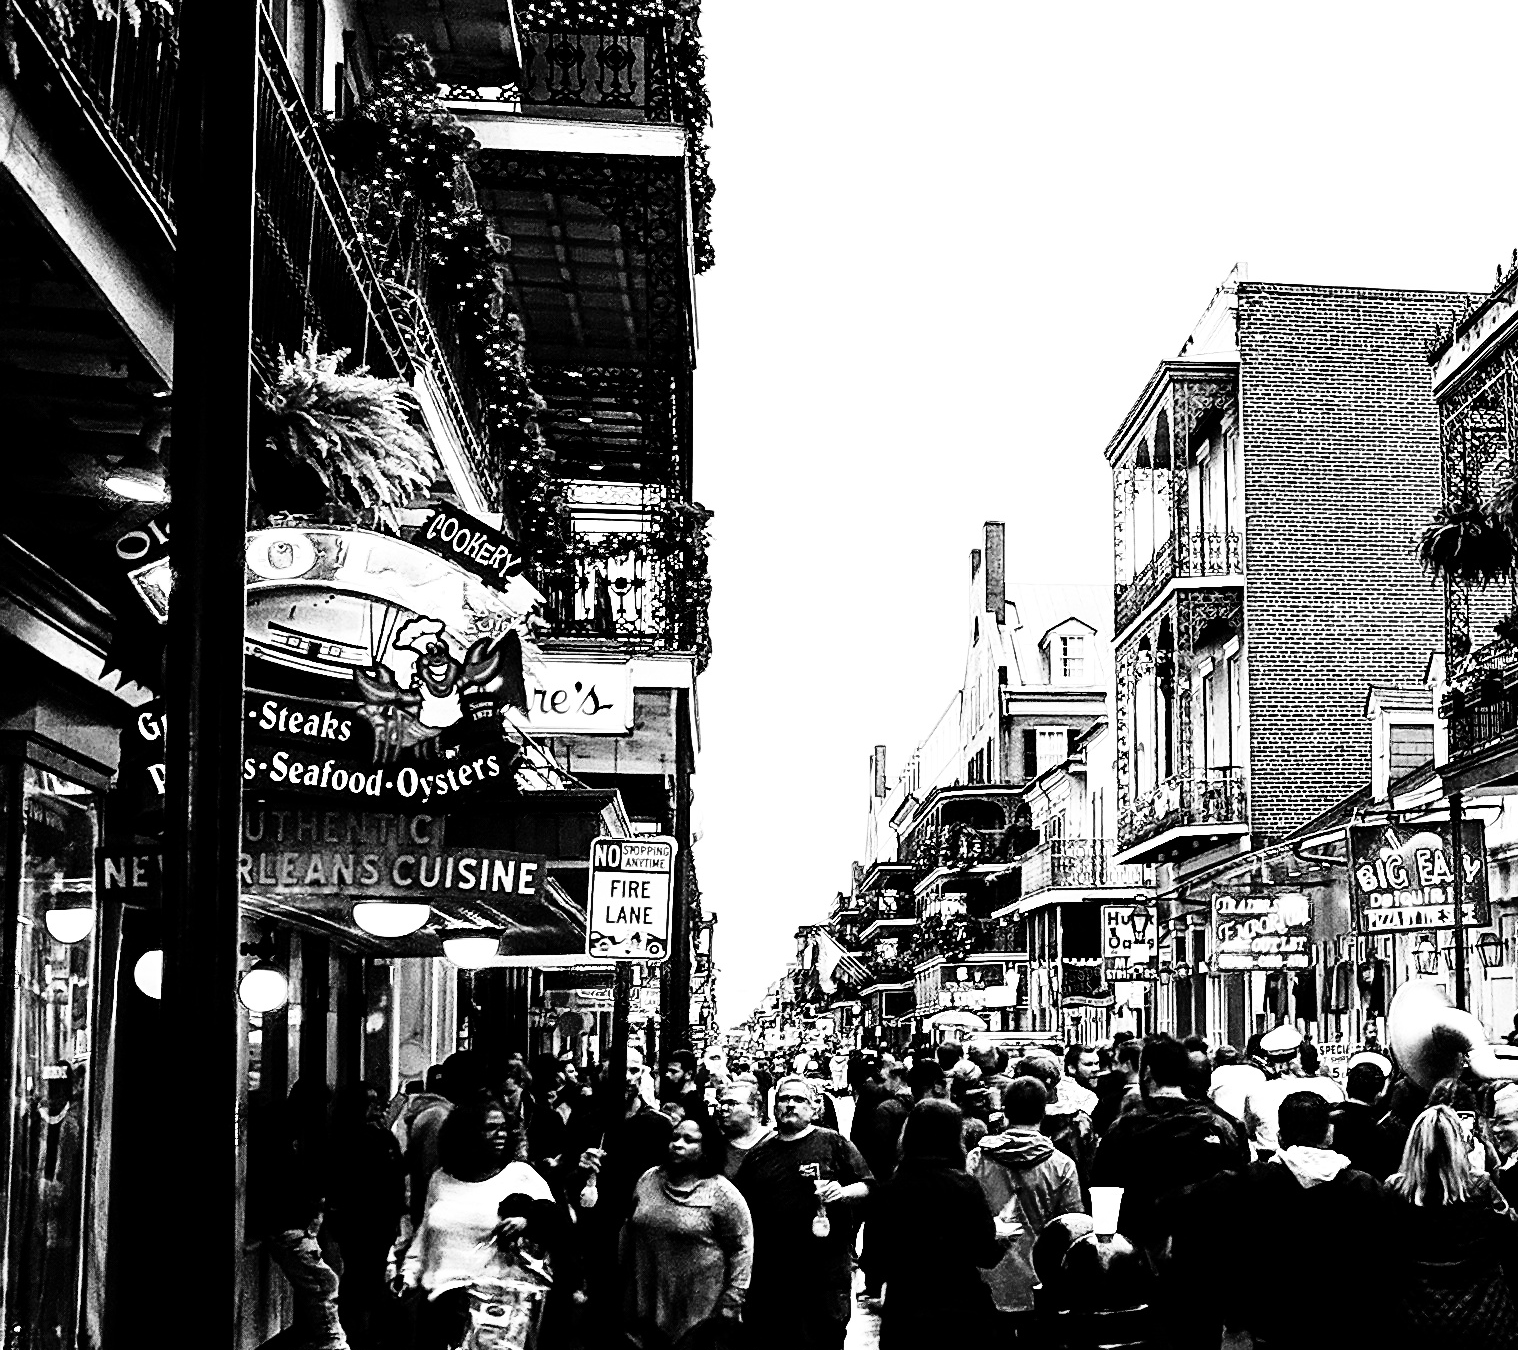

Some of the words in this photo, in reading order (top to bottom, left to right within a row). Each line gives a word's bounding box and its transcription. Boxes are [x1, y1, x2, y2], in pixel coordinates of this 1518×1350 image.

[427, 514, 521, 577] COOKERY
[259, 701, 352, 742] Steaks
[269, 751, 383, 796] Seafood
[397, 755, 500, 803] Oysters
[244, 811, 433, 844] UTHENTIC
[594, 843, 620, 867] NO
[622, 845, 669, 857] STOPPING
[624, 857, 666, 869] ANYTIME
[104, 855, 164, 889] NE
[240, 853, 380, 885] RLEANS
[392, 855, 538, 895] CUISINE
[1356, 854, 1409, 892] BIG
[1416, 849, 1481, 887] EAY
[610, 879, 651, 899] FIRE
[606, 905, 653, 925] LANE
